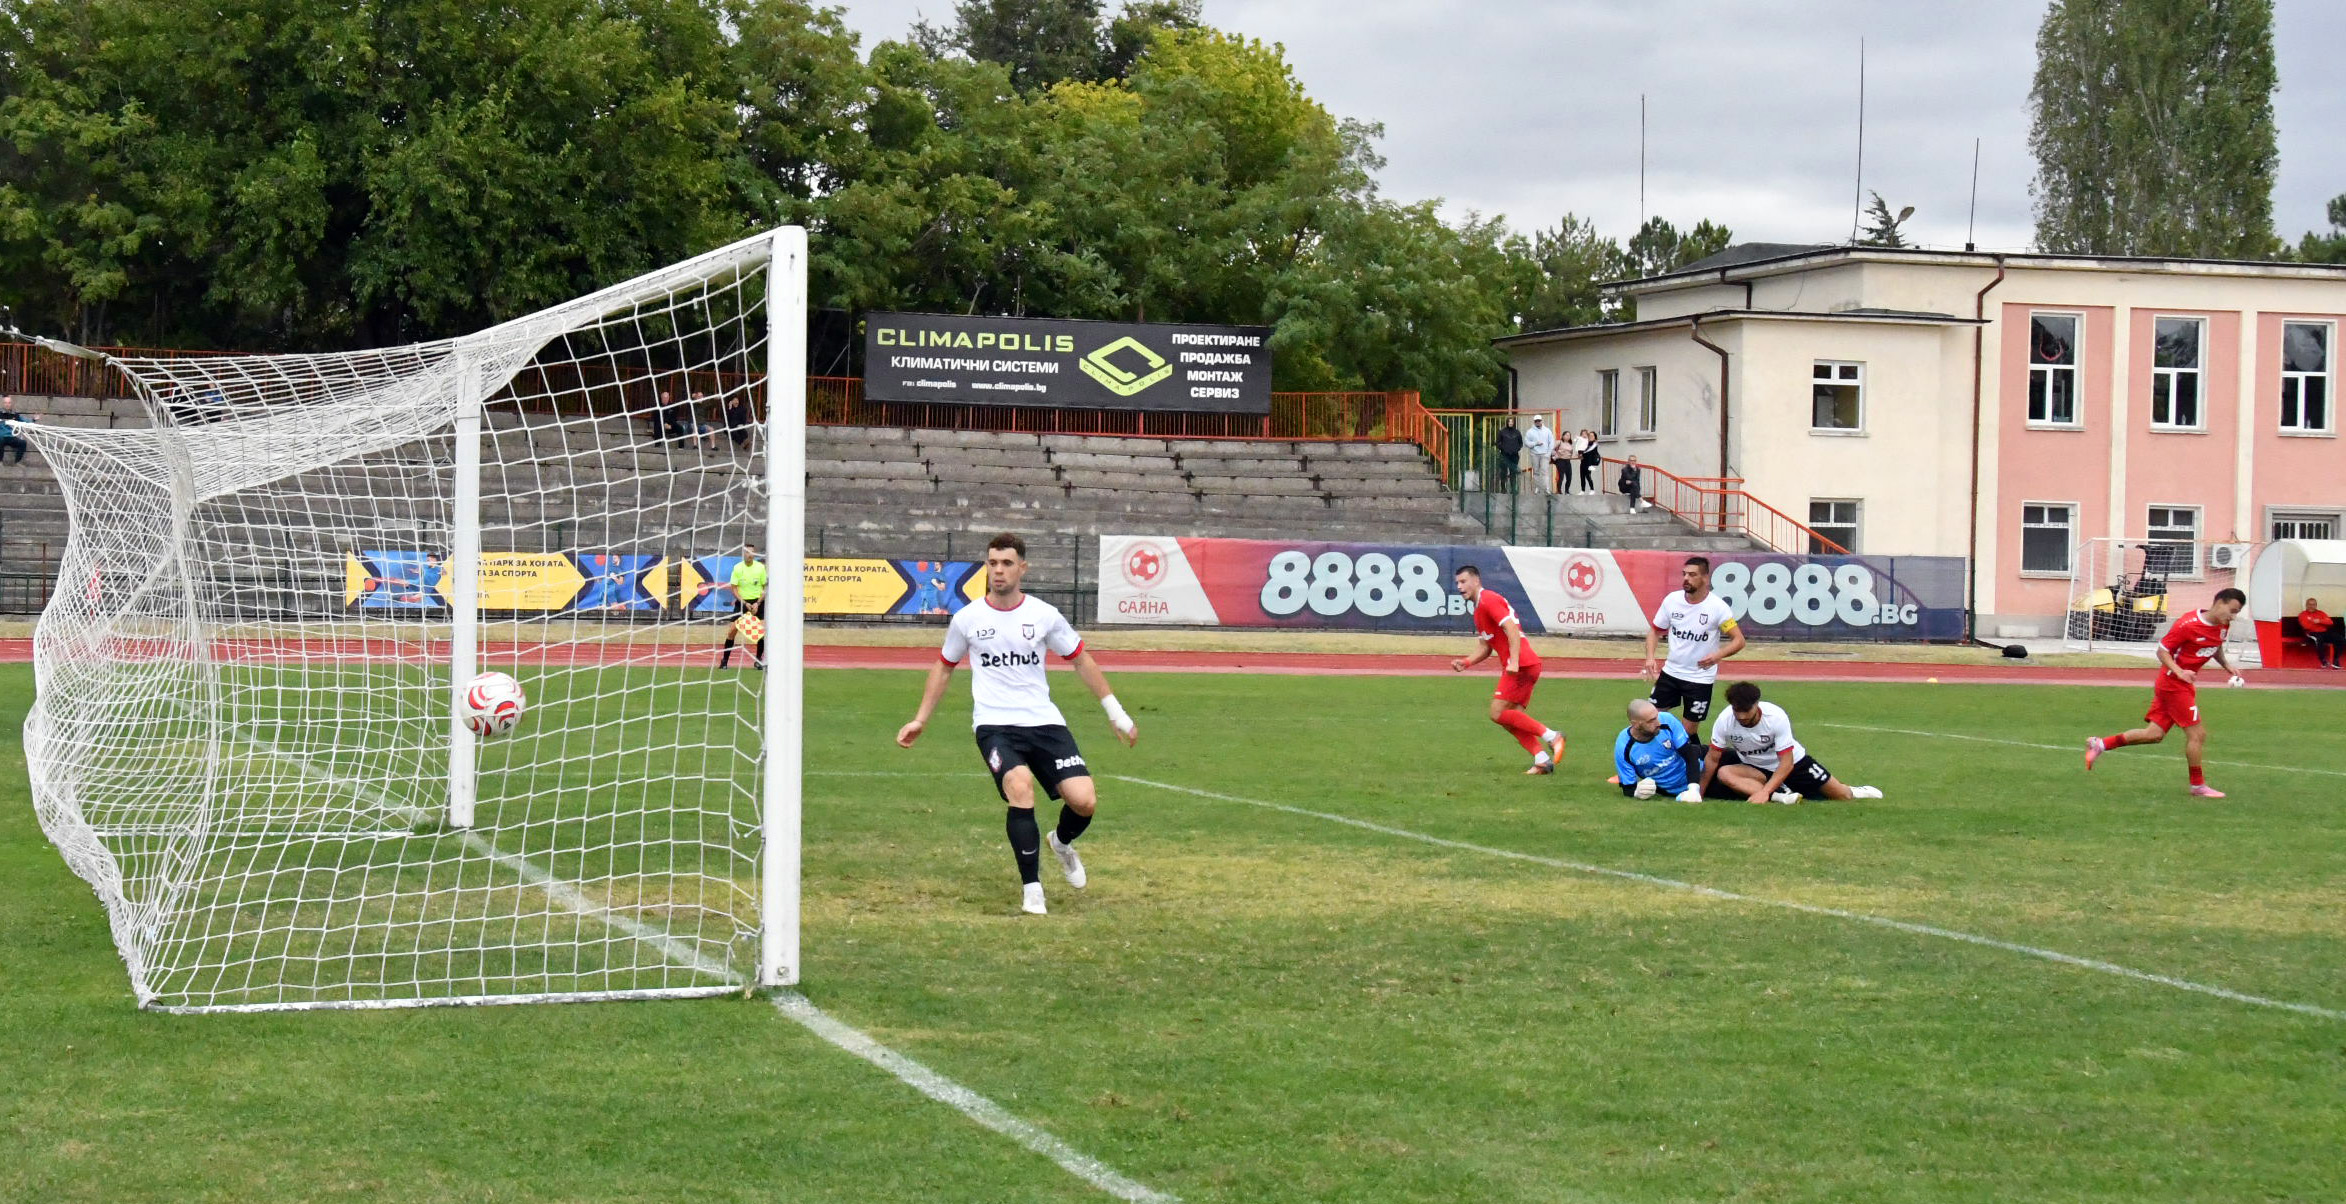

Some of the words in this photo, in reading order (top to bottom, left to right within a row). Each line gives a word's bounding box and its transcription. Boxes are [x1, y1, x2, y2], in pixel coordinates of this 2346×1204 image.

[877, 328, 1074, 353] CLIMAPOLIS
[1172, 333, 1260, 347] ПРОЕКТИРАНЕ
[891, 355, 990, 372] КЛИМАТИЧНИ
[992, 360, 1059, 374] СИСТЕМИ
[1180, 352, 1251, 365] ПРОДАЖБА
[1187, 370, 1243, 382] МОНТАЖ
[916, 379, 957, 389] climapolis
[971, 381, 1047, 393] www.climapolis.bg
[1190, 386, 1240, 398] СЕРВИЗ
[1711, 562, 1918, 626] 8888.BG
[1118, 600, 1169, 614] САЯНА
[1557, 611, 1605, 625] САЯНА
[980, 650, 1040, 667] Bethub
[1690, 701, 1708, 714] 25
[2189, 705, 2198, 721] 7
[1055, 755, 1086, 770] Beth
